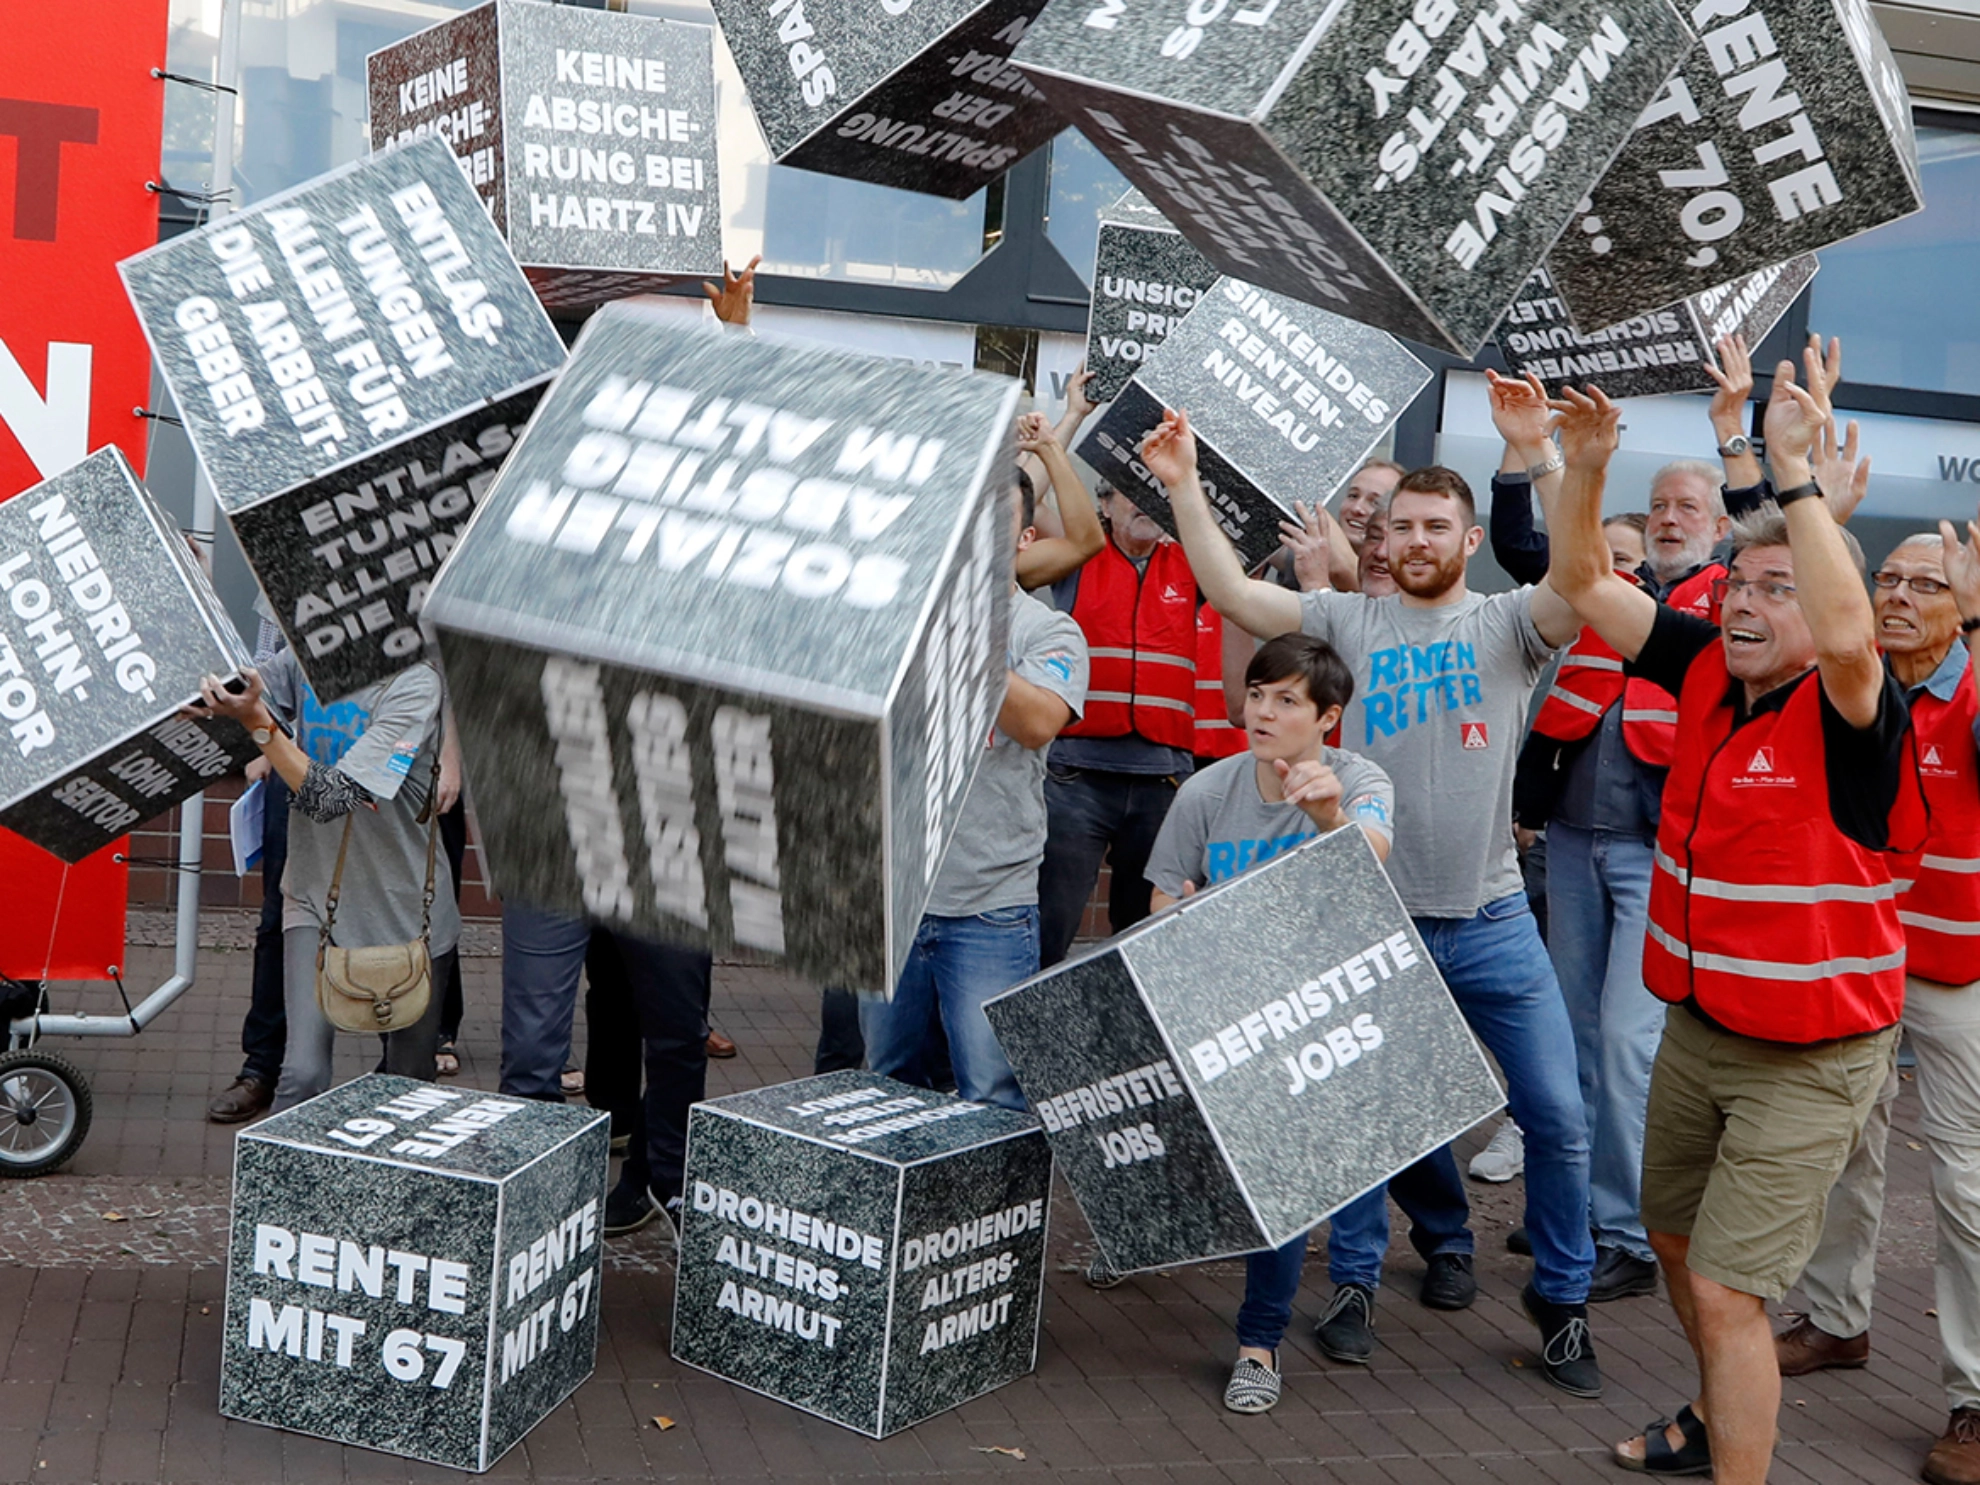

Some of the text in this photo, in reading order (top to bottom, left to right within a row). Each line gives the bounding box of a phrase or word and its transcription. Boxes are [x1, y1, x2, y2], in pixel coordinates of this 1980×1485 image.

[400, 57, 468, 116] KEINE
[556, 49, 666, 93] KEINE
[932, 91, 1016, 129] DER
[1451, 22, 1568, 177] WIRT-
[523, 95, 700, 143] ABSICHE-
[837, 112, 1018, 171] SPALTUNG
[1443, 14, 1630, 271] MASSIVE
[524, 144, 703, 191] RUNG BEI
[530, 193, 656, 234] HARTZ
[667, 203, 702, 237] IV
[1228, 161, 1370, 291] LOBBY
[335, 201, 454, 380] TUNGEN
[389, 180, 503, 347] ENTLAS-
[174, 296, 265, 438] GEBER
[207, 224, 349, 456] DIE ARBEIT-
[262, 206, 409, 439] ALLEIN FÜR
[1223, 278, 1391, 424] SINKENDES
[1201, 349, 1321, 453] NIVEAU
[1218, 318, 1346, 430] RENTEN-
[582, 373, 947, 487] IM ALTER
[312, 468, 496, 570] TUNGE
[560, 432, 917, 541] ABSTIEG
[505, 479, 909, 610] SOZIALER
[0, 551, 93, 702] LOHN-
[28, 492, 157, 704] NIEDRIG-
[304, 599, 395, 660] DIE
[1361, 673, 1483, 746] RETTER
[1368, 641, 1477, 692] RENTEN
[52, 776, 140, 833] SEKTOR
[1188, 931, 1420, 1083] BEFRISTETE
[1036, 1060, 1184, 1135] BEFRISTETE
[1283, 1013, 1384, 1096] JOBS
[327, 1087, 463, 1149] MIT 67
[391, 1099, 526, 1159] RENTE
[1098, 1121, 1166, 1169] JOBS
[253, 1223, 469, 1315] RENTE
[506, 1198, 599, 1309] RENTE
[692, 1181, 884, 1271] DROHENDE
[714, 1234, 850, 1302] ALTERS-
[902, 1199, 1044, 1272] DROHENDE
[501, 1267, 594, 1386] MIT 67
[716, 1280, 842, 1349] ARMUT
[919, 1251, 1020, 1312] ALTERS-
[919, 1293, 1014, 1356] ARMUT
[248, 1297, 467, 1390] MIT 67
